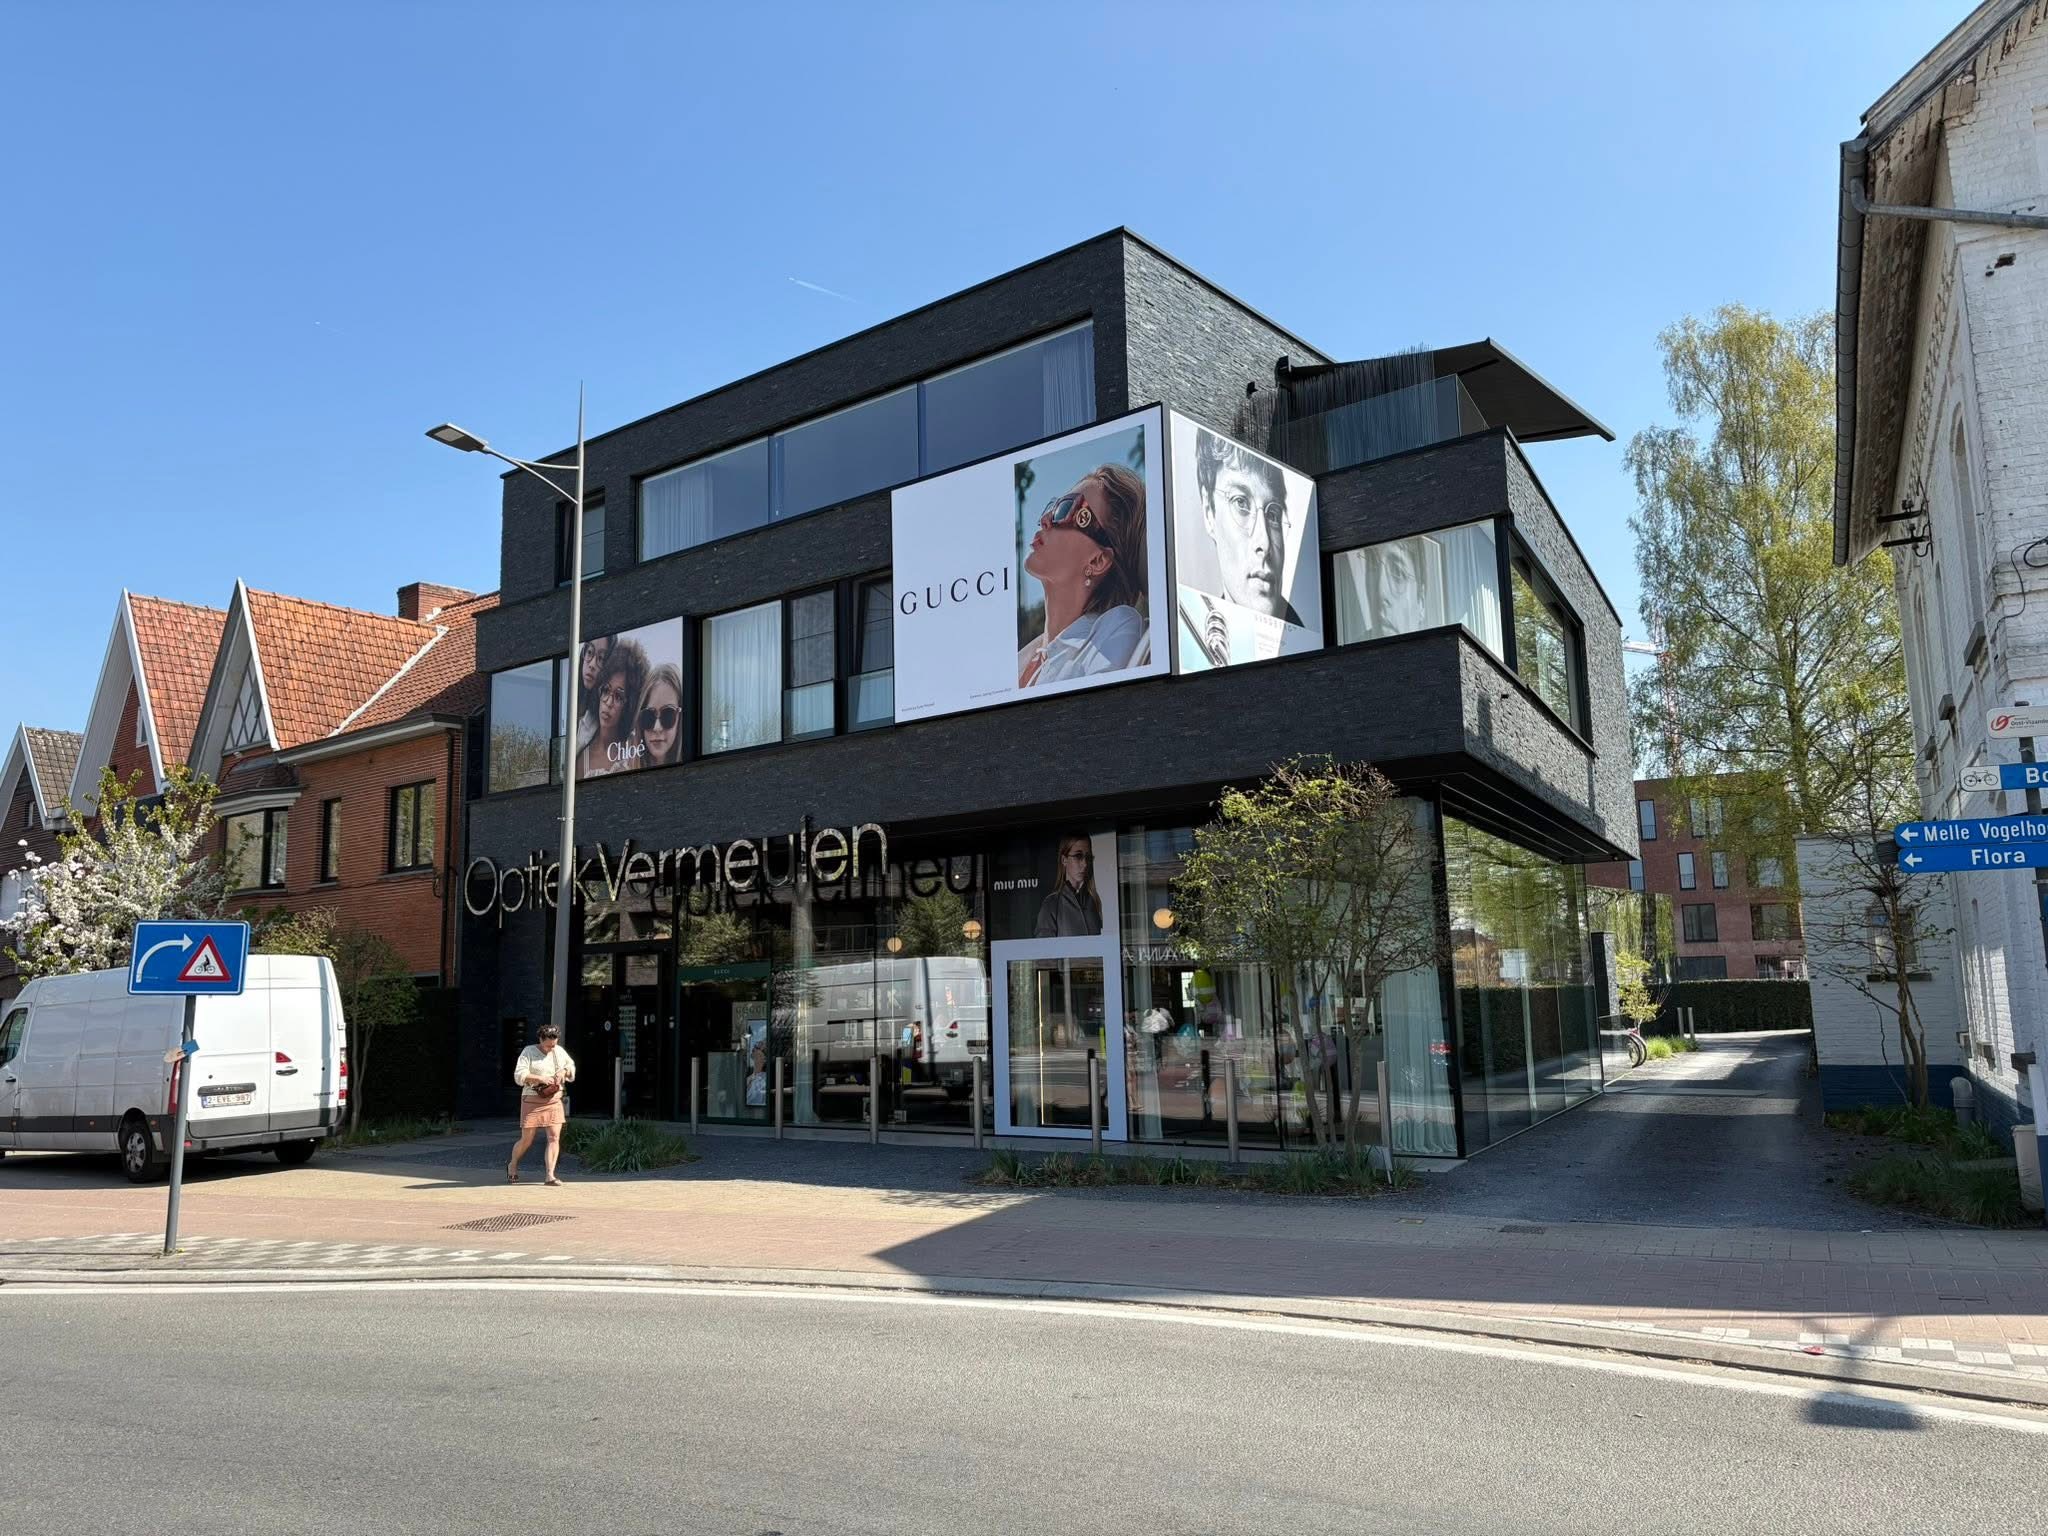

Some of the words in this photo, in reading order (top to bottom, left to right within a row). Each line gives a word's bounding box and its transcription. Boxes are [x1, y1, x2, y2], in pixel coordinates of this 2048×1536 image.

[900, 566, 1008, 615] GUCCI
[607, 739, 646, 762] Chloé
[1924, 824, 1971, 842] Melle
[1979, 820, 2048, 842] Vogelho
[1971, 848, 2026, 866] Flora
[464, 846, 594, 929] Optiek
[596, 814, 888, 902] Vermeulen
